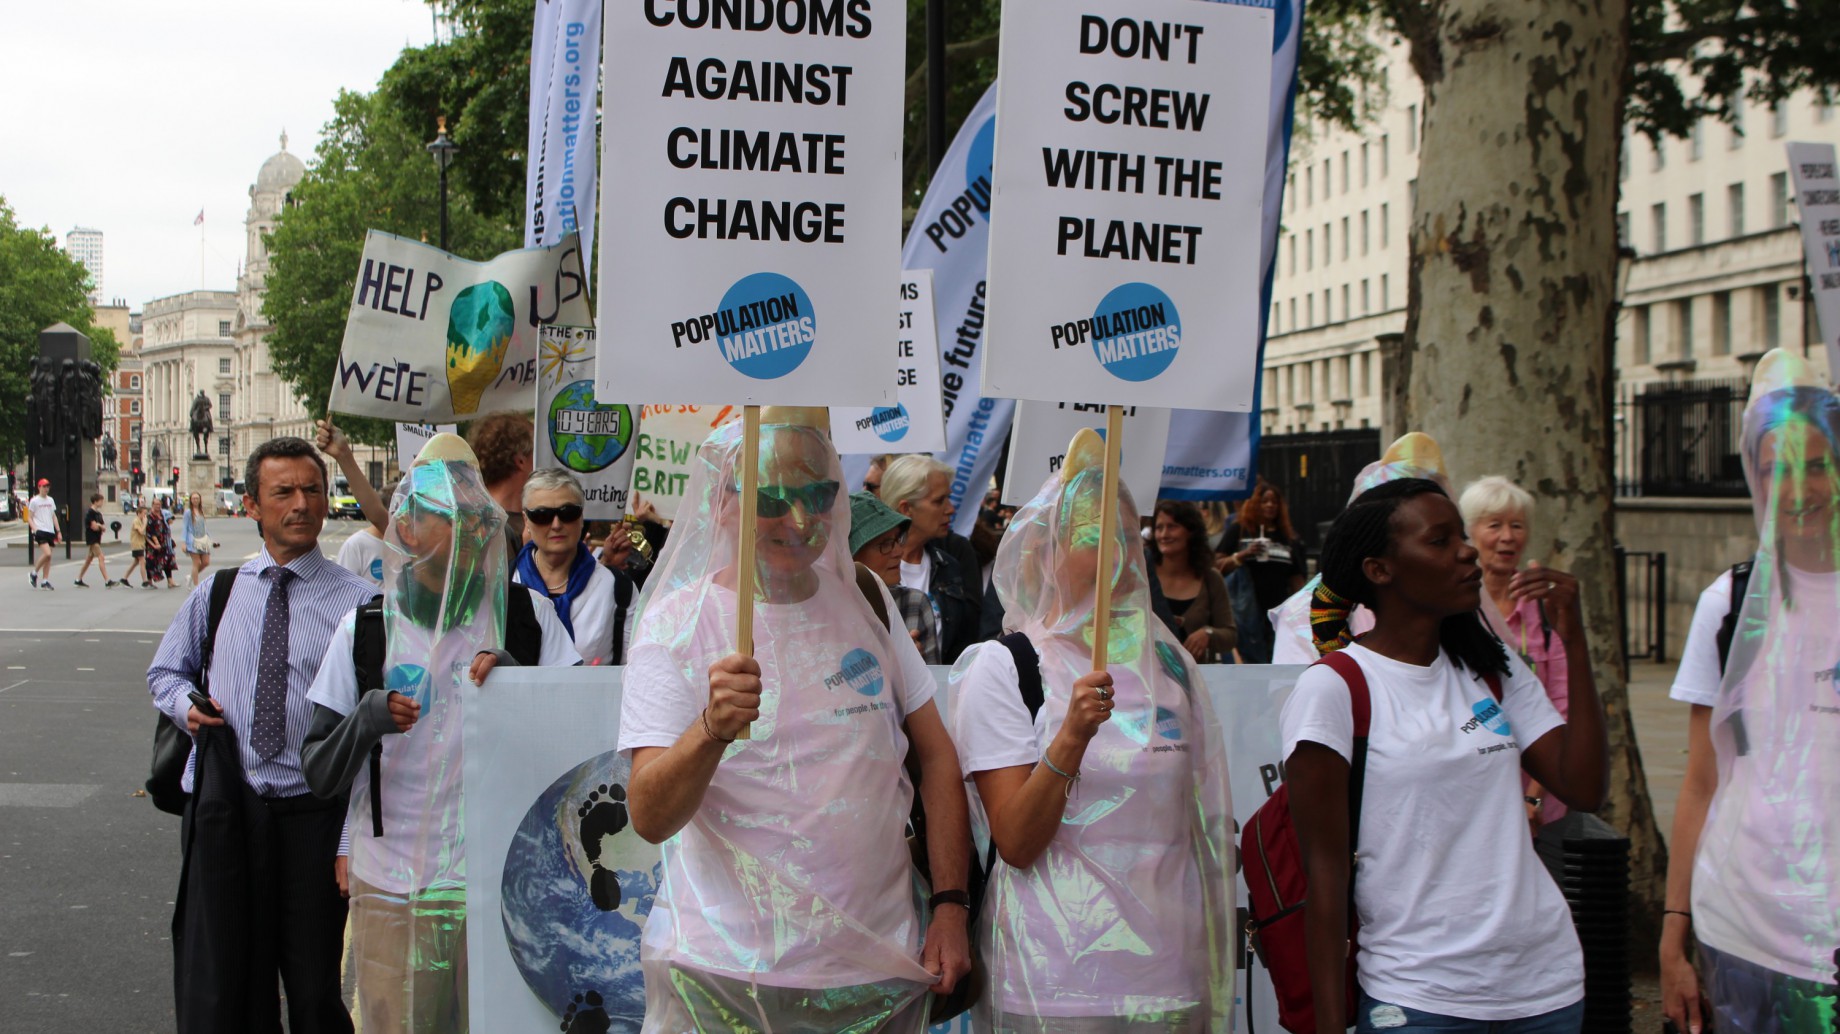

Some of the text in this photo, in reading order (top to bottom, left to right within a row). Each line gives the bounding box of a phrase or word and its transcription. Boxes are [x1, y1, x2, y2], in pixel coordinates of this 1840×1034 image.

[643, 0, 872, 39] CONDOMS
[1080, 14, 1204, 64] DON'T
[661, 57, 853, 106] AGAINST
[1064, 81, 1211, 132] SCREW
[667, 126, 846, 175] CLIMATE
[1042, 147, 1223, 200] WITH THE
[664, 196, 845, 243] CHANGE
[1057, 216, 1203, 265] PLANET
[357, 248, 582, 328] HELP US
[671, 292, 799, 348] POPULATION
[723, 316, 815, 363] MATTERS
[943, 280, 986, 369] future
[1051, 302, 1167, 349] POPULATION
[1097, 324, 1180, 364] MATTERS
[402, 423, 425, 437] SMALL
[556, 410, 571, 433] 10
[576, 410, 619, 434] YEARS
[855, 407, 901, 431] POPULATION
[874, 415, 909, 436] MATTERS
[824, 655, 875, 690] POPULATION
